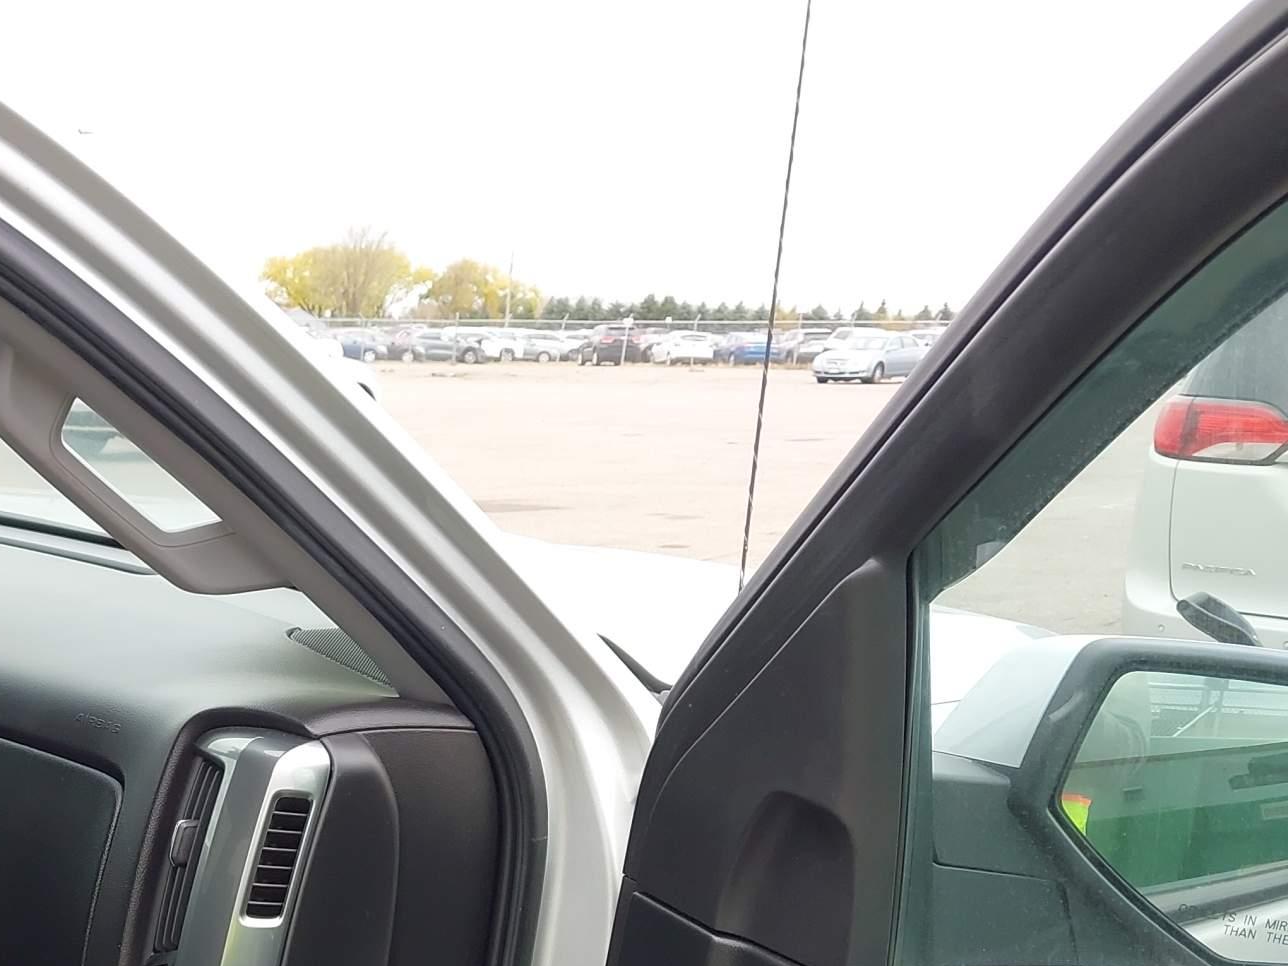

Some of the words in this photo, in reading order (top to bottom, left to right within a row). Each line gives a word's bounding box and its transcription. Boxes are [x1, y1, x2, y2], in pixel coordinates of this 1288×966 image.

[1243, 914, 1258, 927] IN
[1264, 917, 1288, 932] MIR
[1224, 924, 1258, 940] THAN
